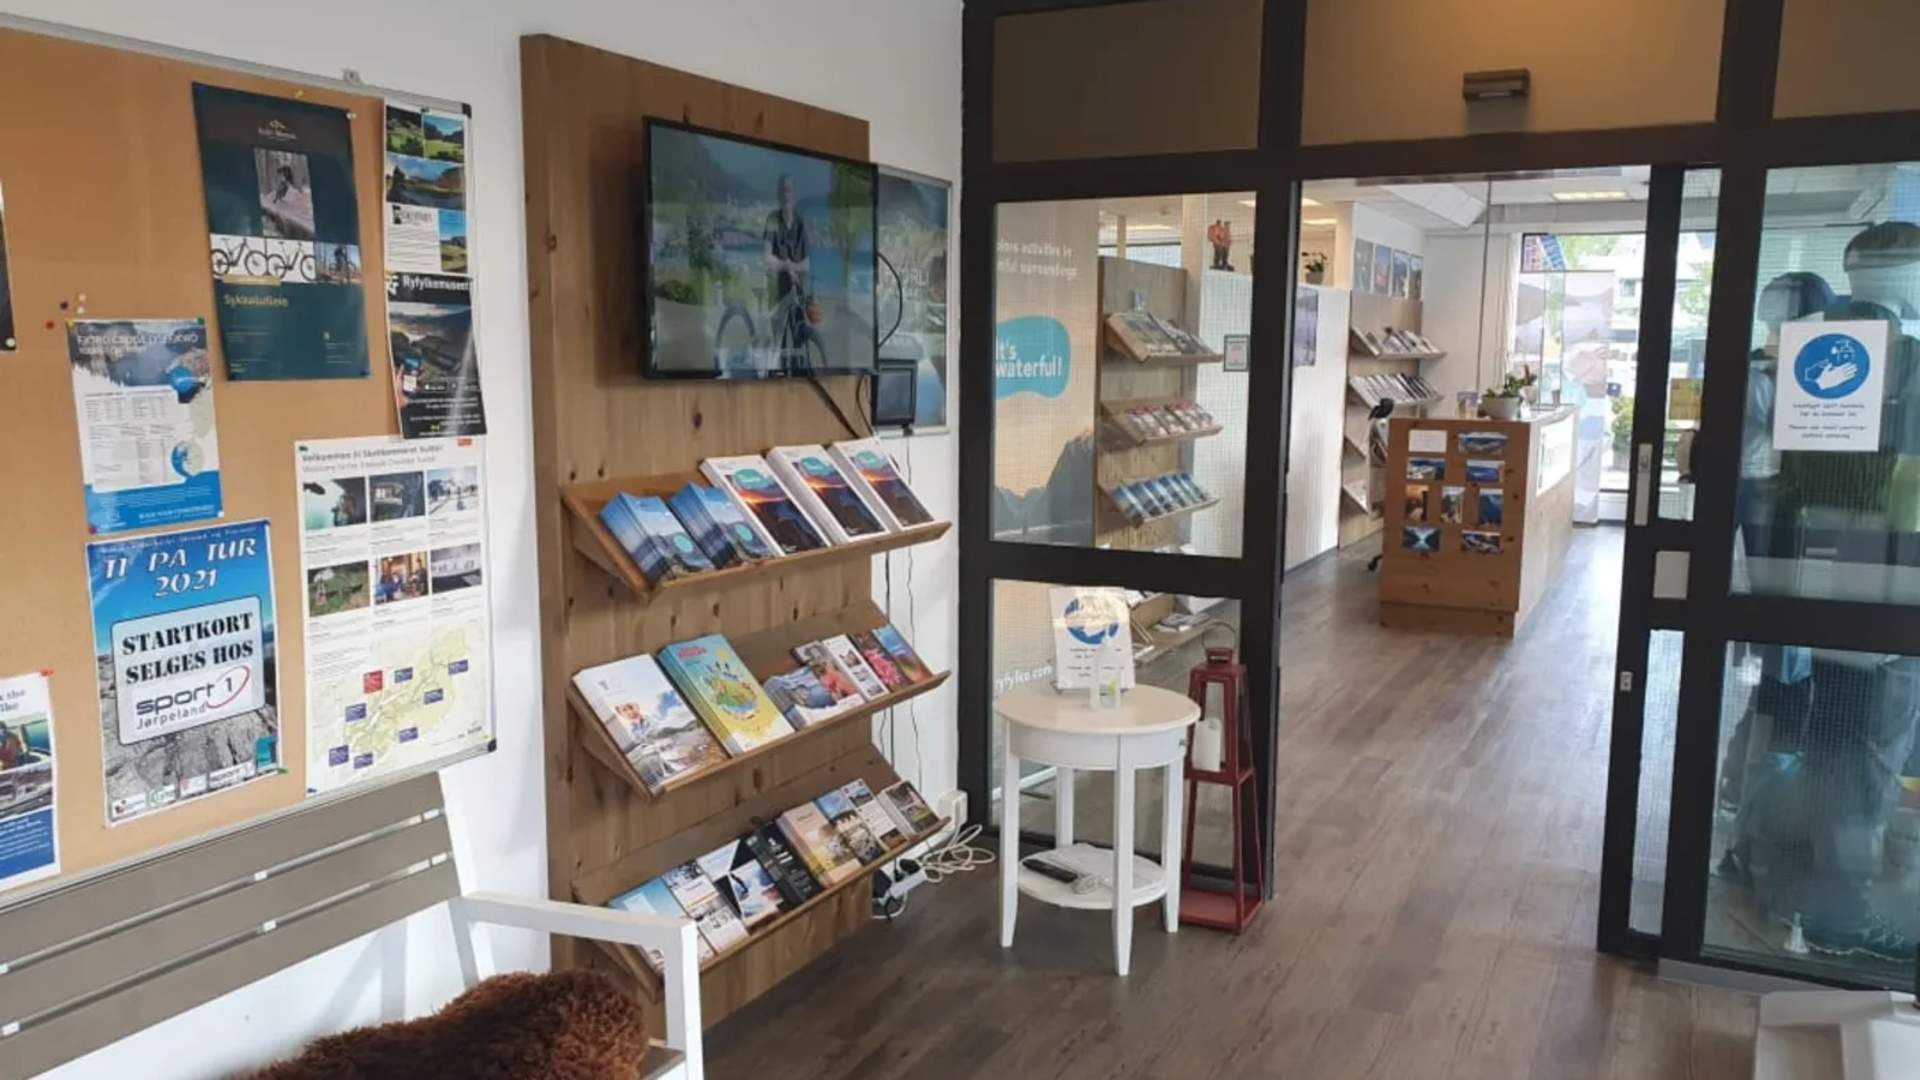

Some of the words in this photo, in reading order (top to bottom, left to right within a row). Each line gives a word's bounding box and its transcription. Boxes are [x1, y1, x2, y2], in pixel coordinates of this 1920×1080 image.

[105, 557, 128, 579] TI
[207, 538, 256, 562] TUR
[154, 569, 218, 597] 2021
[121, 611, 254, 656] STARTKORT
[125, 649, 207, 685] SELGES
[212, 639, 254, 665] HOS
[136, 682, 215, 716] sport
[224, 676, 233, 693] 1
[136, 701, 208, 730] Jørpeland
